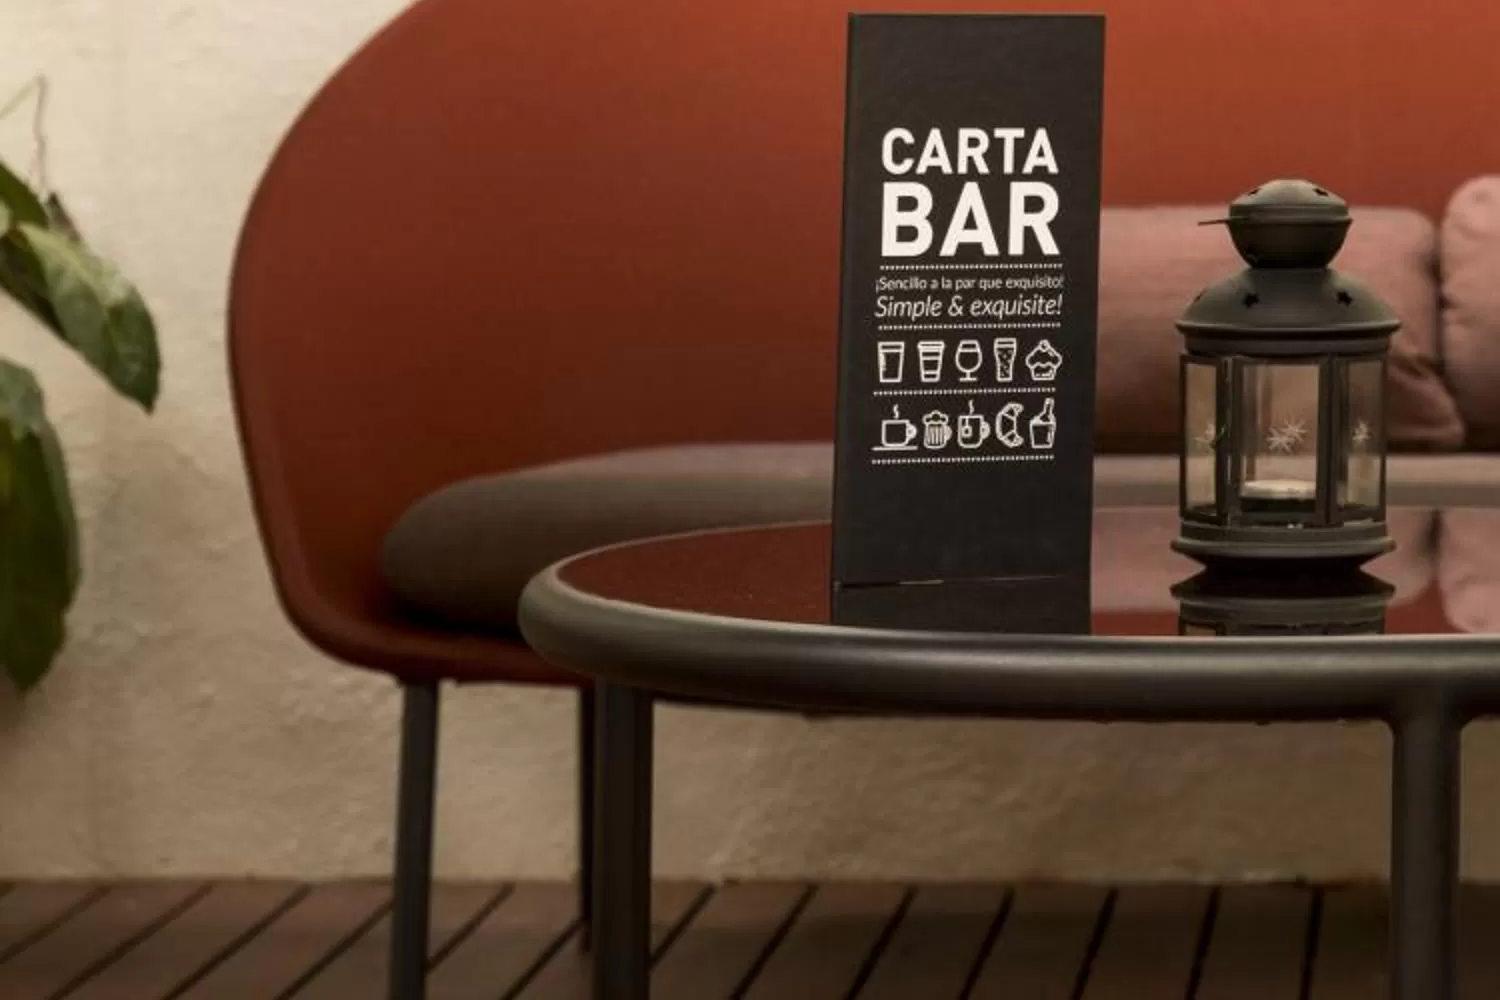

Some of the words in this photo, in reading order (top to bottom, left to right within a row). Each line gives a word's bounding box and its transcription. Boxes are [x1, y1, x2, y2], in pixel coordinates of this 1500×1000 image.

[881, 127, 1060, 176] CARTA
[881, 181, 1061, 257] BAR
[929, 279, 939, 290] a
[941, 275, 953, 290] la
[955, 278, 976, 292] par
[979, 278, 1003, 291] que
[1005, 273, 1065, 291] exquisito!
[874, 295, 942, 322] Simple
[947, 294, 965, 317] &
[969, 292, 1063, 320] exquisite!
